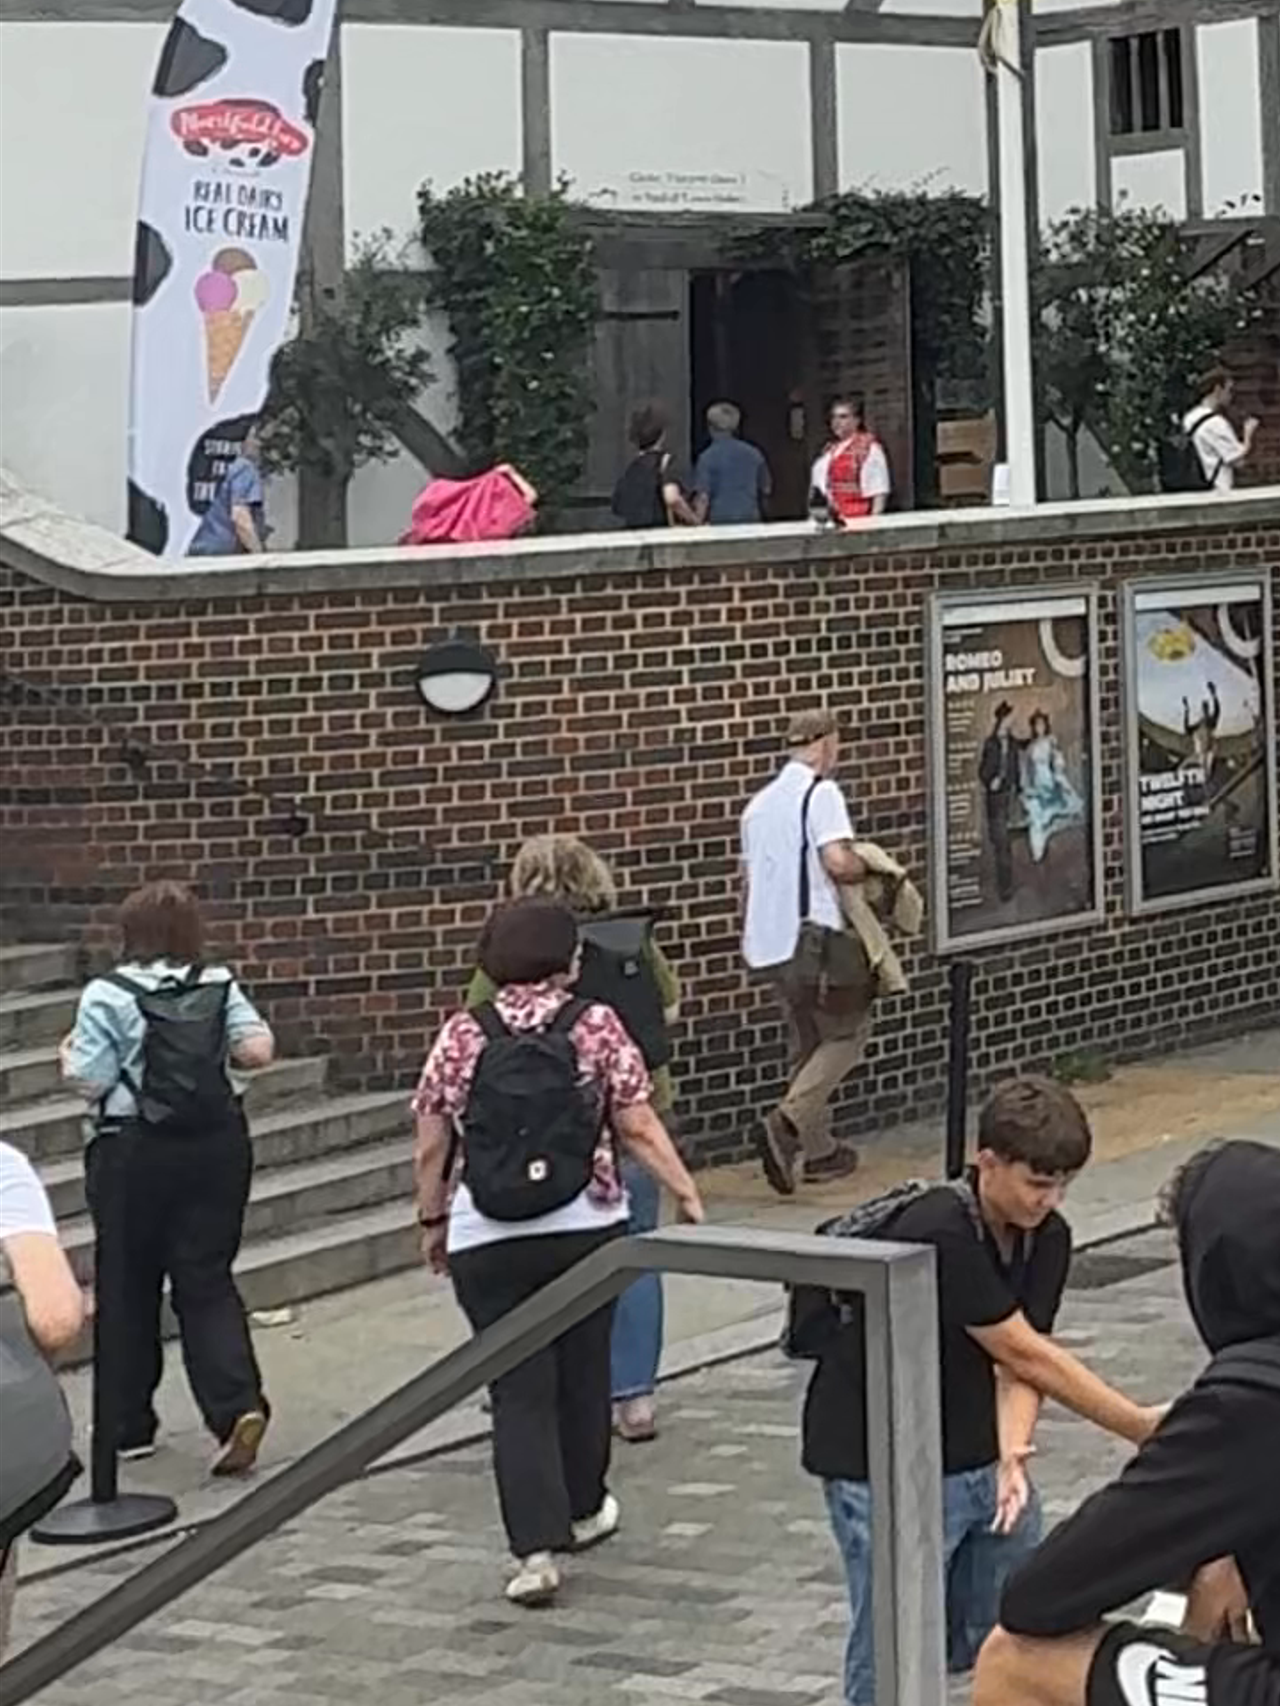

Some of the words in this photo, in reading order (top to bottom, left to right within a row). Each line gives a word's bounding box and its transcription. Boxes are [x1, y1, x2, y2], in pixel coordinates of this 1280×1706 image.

[193, 179, 232, 205] REAL
[184, 205, 215, 234] ICE
[222, 207, 289, 243] CREAM
[945, 650, 1003, 671] ROMEO
[946, 673, 981, 693] AND
[983, 667, 1036, 693] JULIET
[1141, 790, 1184, 811] NIGHT
